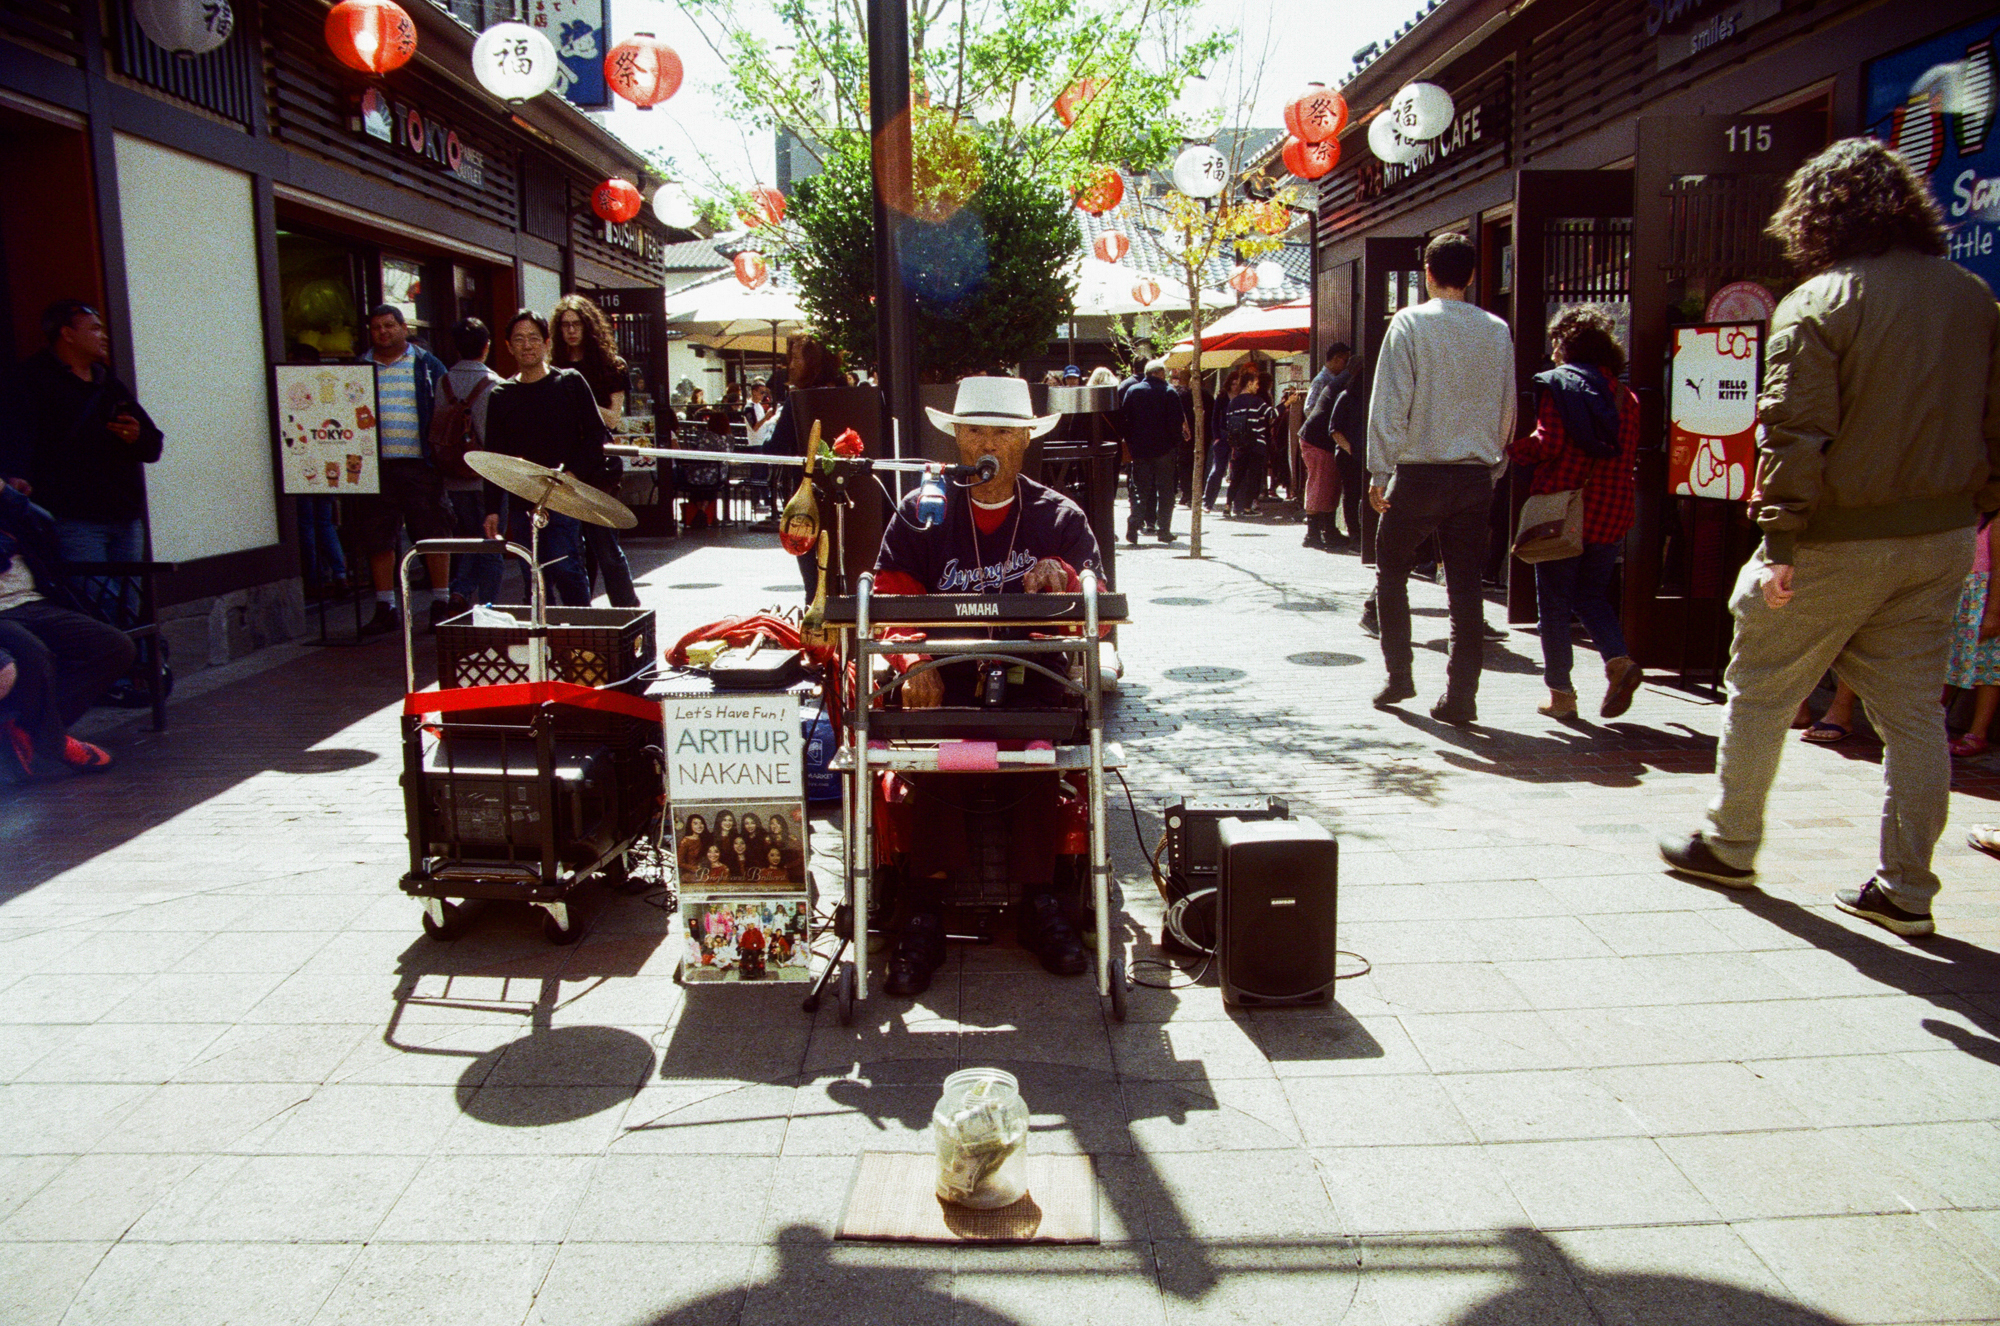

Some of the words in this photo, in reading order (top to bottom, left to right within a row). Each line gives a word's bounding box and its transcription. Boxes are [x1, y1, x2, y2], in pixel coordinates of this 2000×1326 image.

[493, 38, 533, 75] 福
[614, 51, 647, 87] 祭
[1306, 98, 1336, 126] 祭
[1393, 98, 1417, 127] 福
[395, 101, 461, 171] TOKYO
[1440, 104, 1481, 157] CAFE
[1724, 125, 1771, 152] 115
[1202, 155, 1226, 181] 福
[1941, 224, 1993, 261] ittle
[599, 294, 620, 307] 116
[1718, 380, 1747, 390] HELLO
[1718, 390, 1748, 401] KITTY
[311, 429, 353, 440] TOKYO
[955, 603, 999, 616] YAMAHA
[675, 706, 712, 720] Let's
[716, 706, 750, 719] Have
[675, 728, 790, 755] ARTHUR
[678, 762, 791, 785] NAKANE
